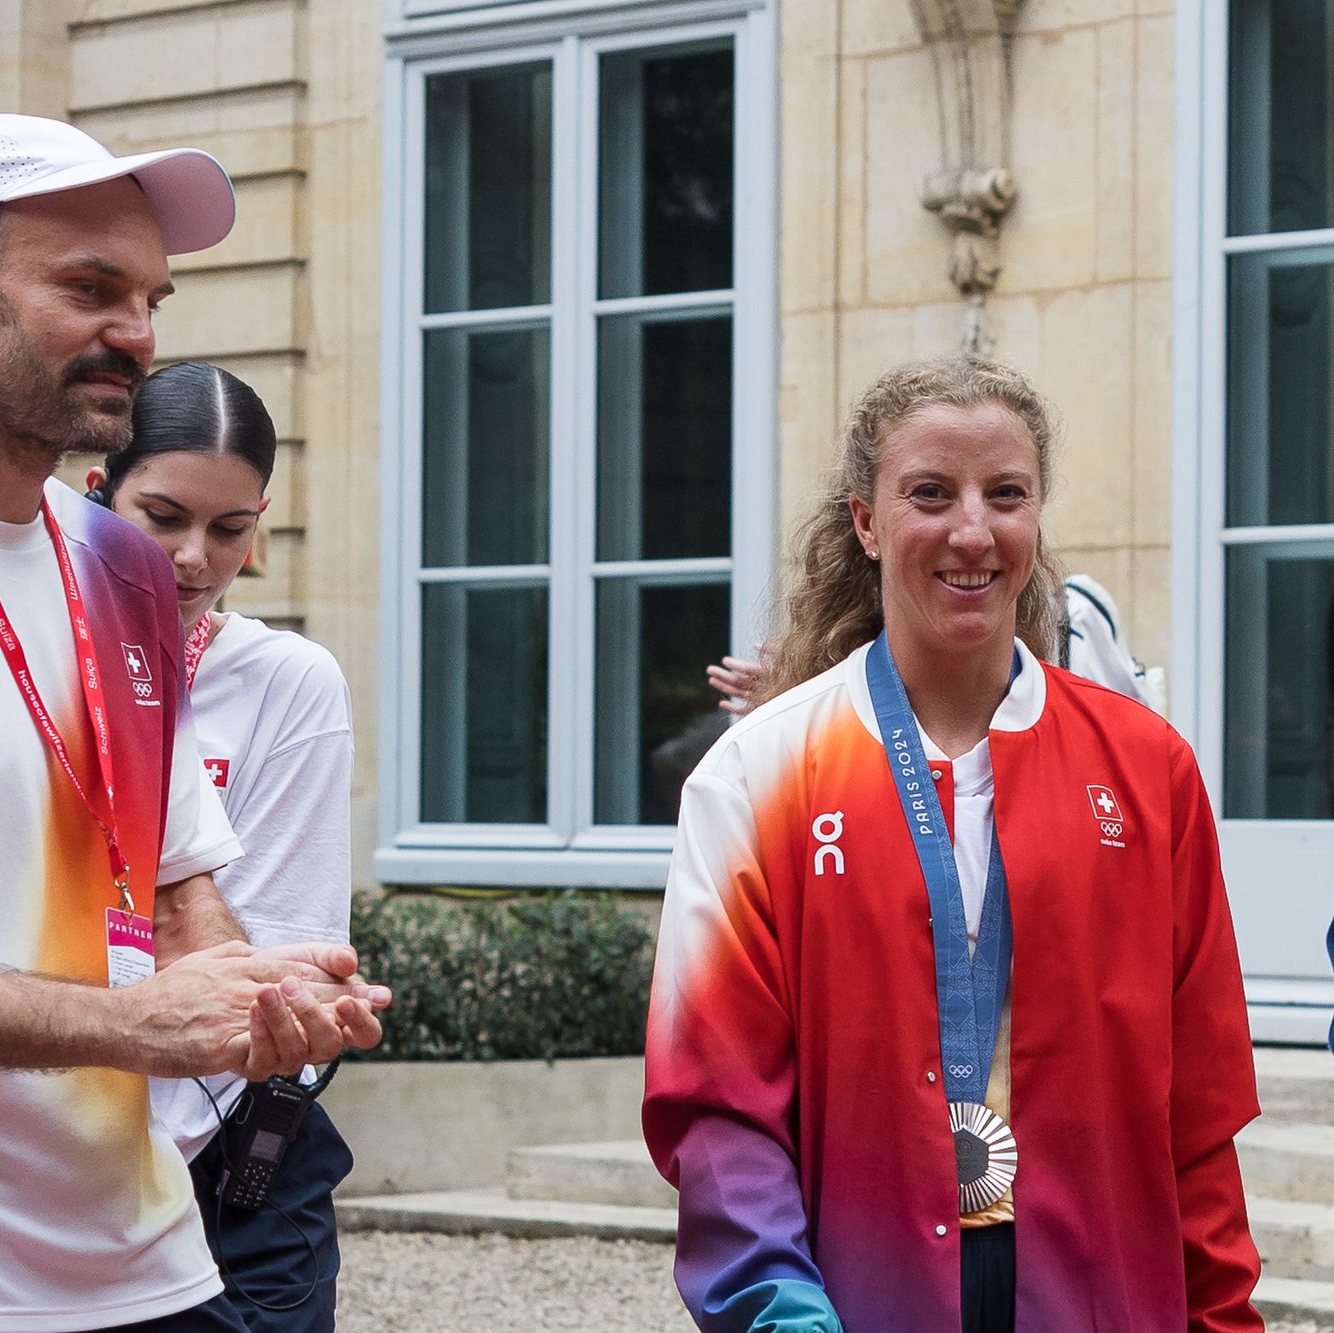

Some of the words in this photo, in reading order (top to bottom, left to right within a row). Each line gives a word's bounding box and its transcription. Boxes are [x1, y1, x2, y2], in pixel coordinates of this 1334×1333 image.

[94, 706, 109, 756] Schweiz
[891, 728, 916, 777] 2024
[108, 920, 153, 941] PARTNER
